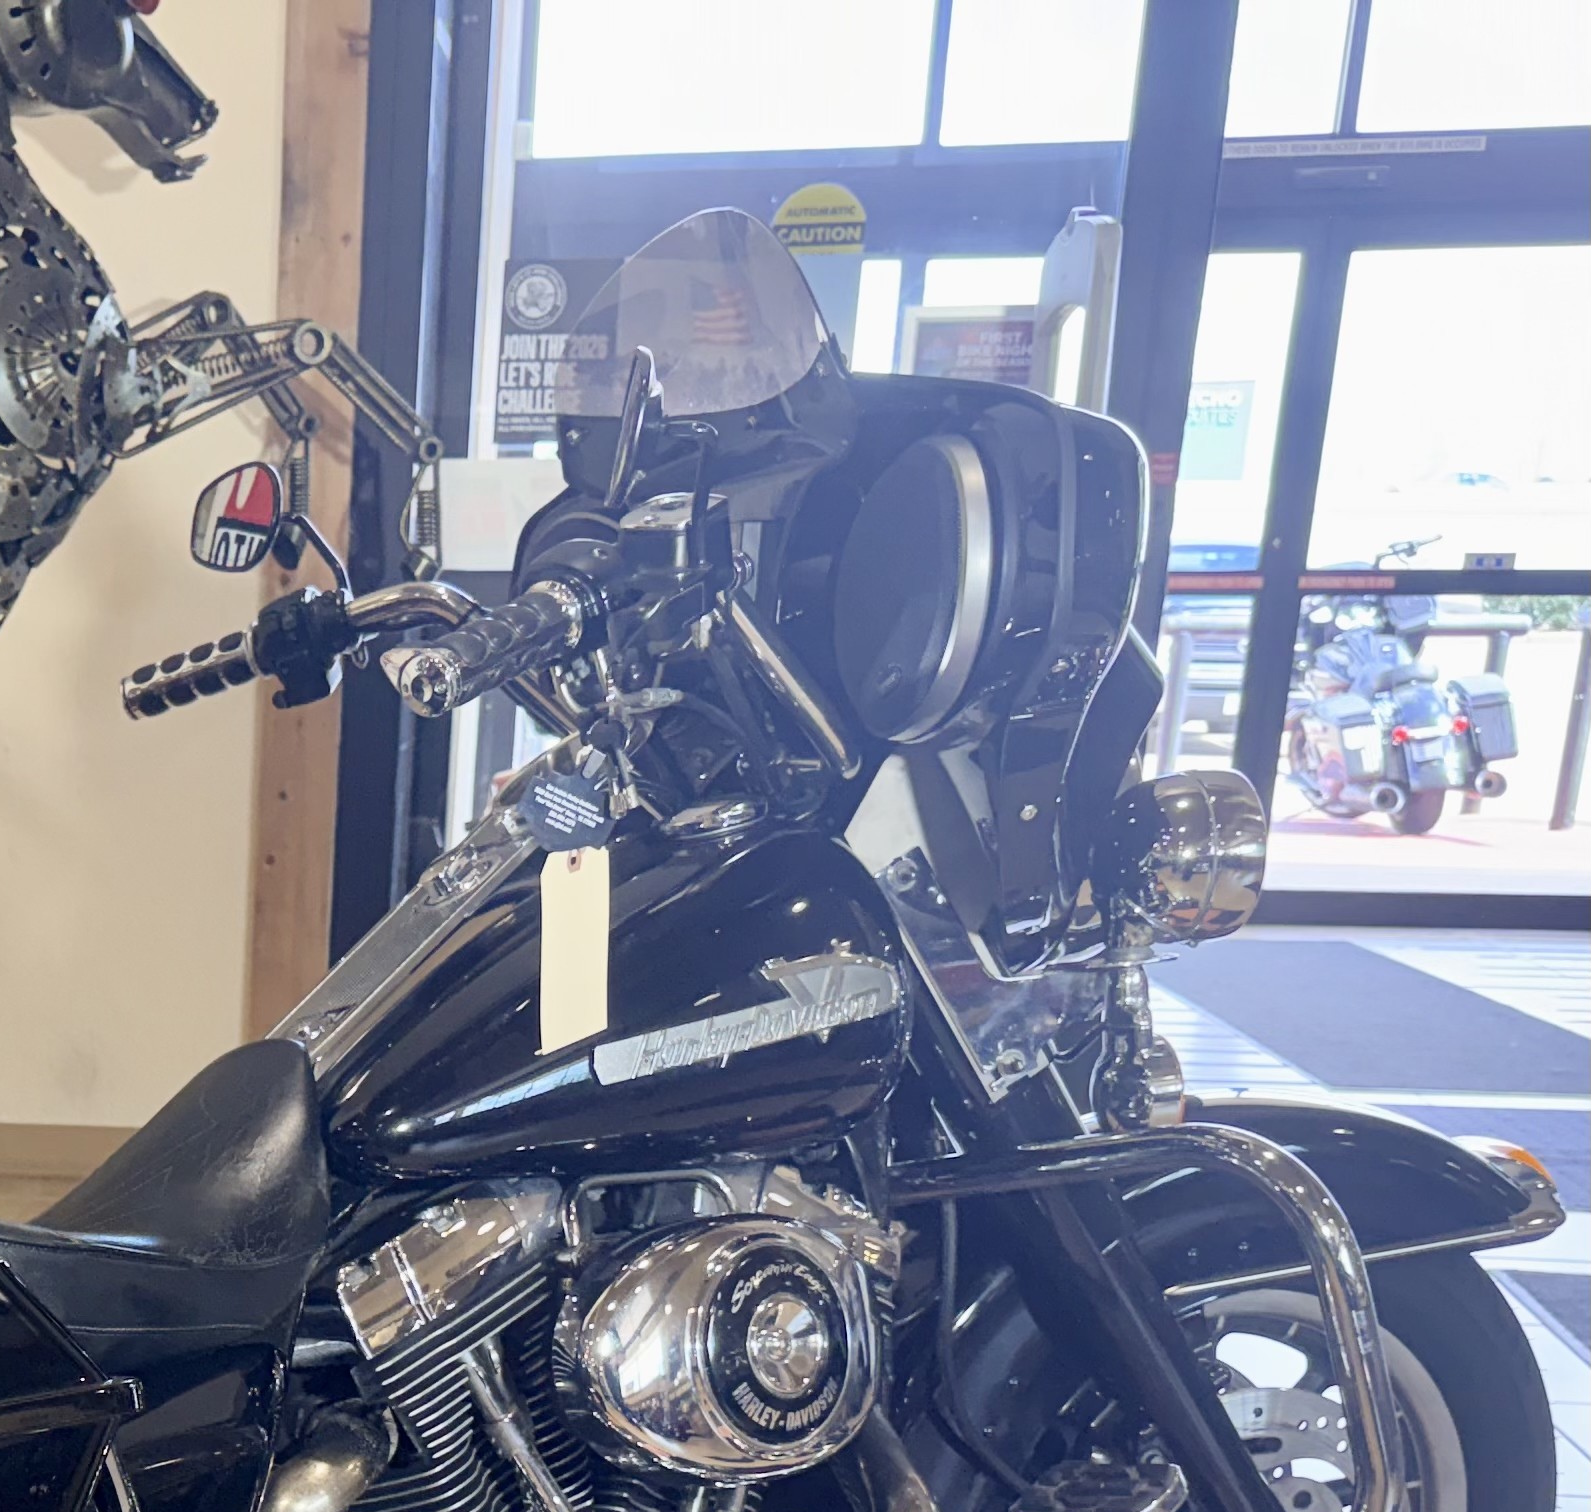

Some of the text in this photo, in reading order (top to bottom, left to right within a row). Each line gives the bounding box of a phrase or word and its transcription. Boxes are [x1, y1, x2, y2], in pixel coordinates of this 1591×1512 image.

[787, 205, 857, 218] AUTOMATIC
[777, 225, 862, 244] CAUTION
[501, 333, 537, 360] JOIN
[538, 333, 569, 360] THE
[731, 1376, 838, 1431] HARLEY-DAVIDSON
